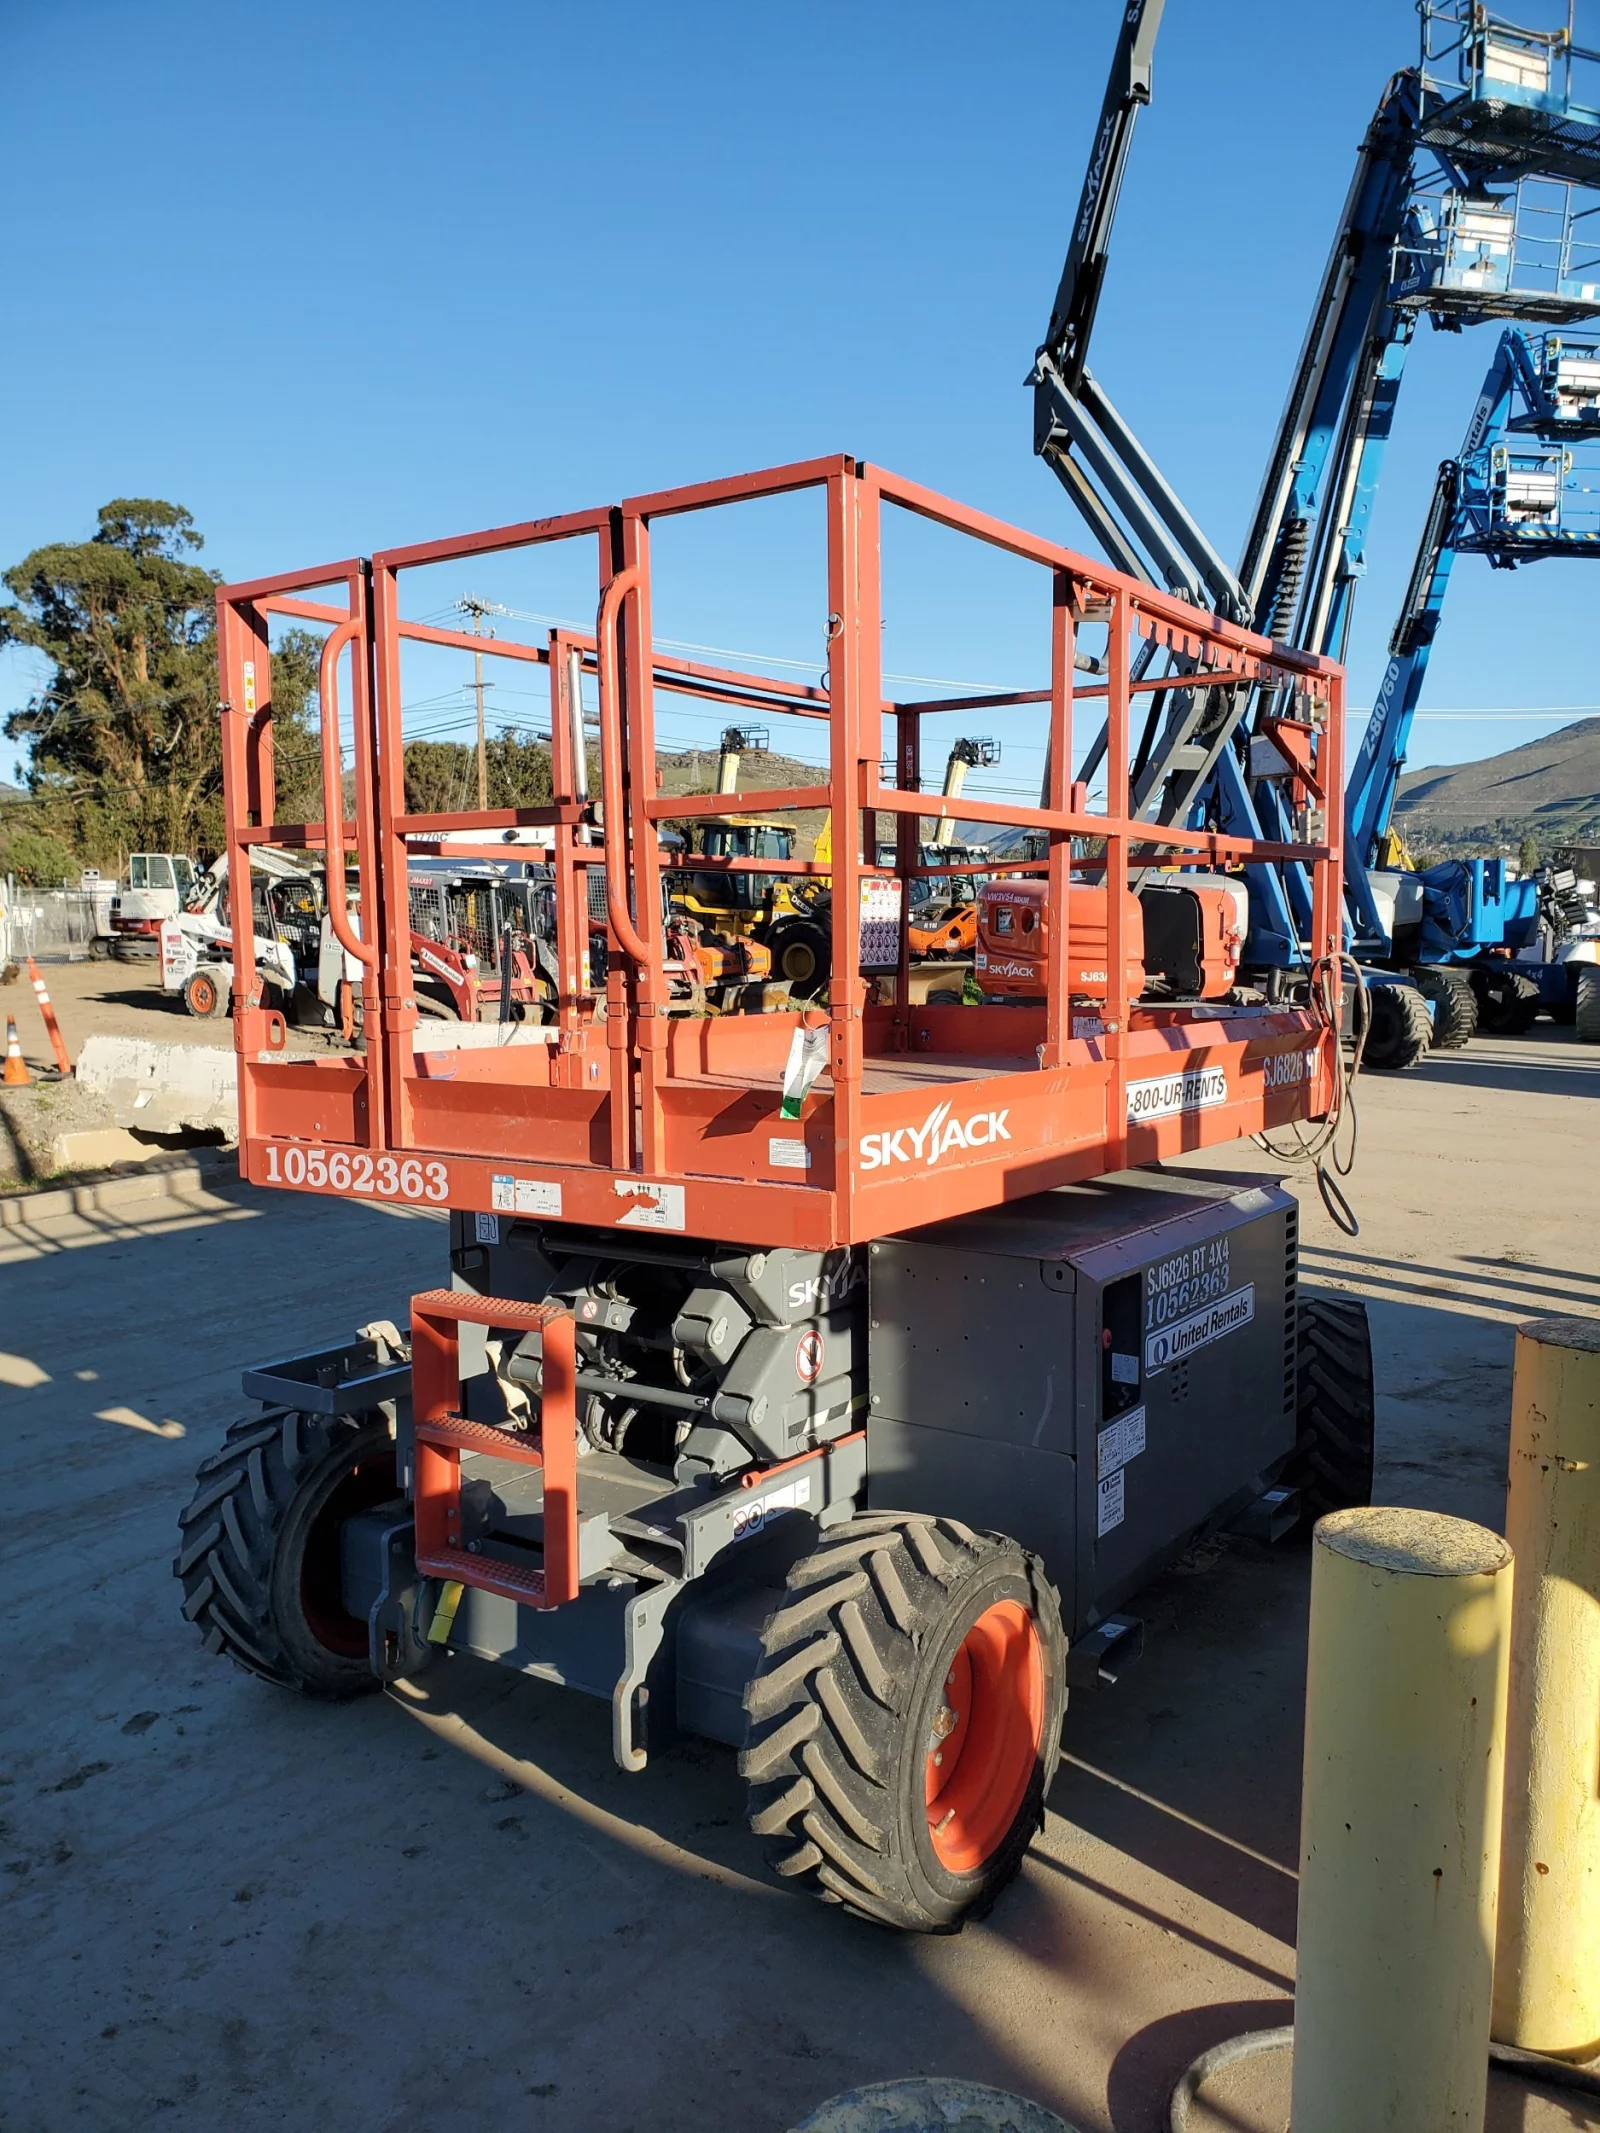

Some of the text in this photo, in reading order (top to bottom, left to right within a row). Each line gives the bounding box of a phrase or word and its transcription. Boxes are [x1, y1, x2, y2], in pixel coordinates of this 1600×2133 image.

[1077, 113, 1115, 243] SKYJACK
[1362, 662, 1400, 760] Z-80/60
[989, 961, 1034, 977] SKYJACK
[1263, 1047, 1320, 1087] SJ6826 RT
[859, 1099, 1012, 1170] SKYJACK
[265, 1146, 449, 1201] 10562363
[788, 1253, 868, 1308] SKYJA
[1147, 1236, 1230, 1296] SJ6826 RT 4X4
[1171, 1297, 1248, 1354] United Rentals
